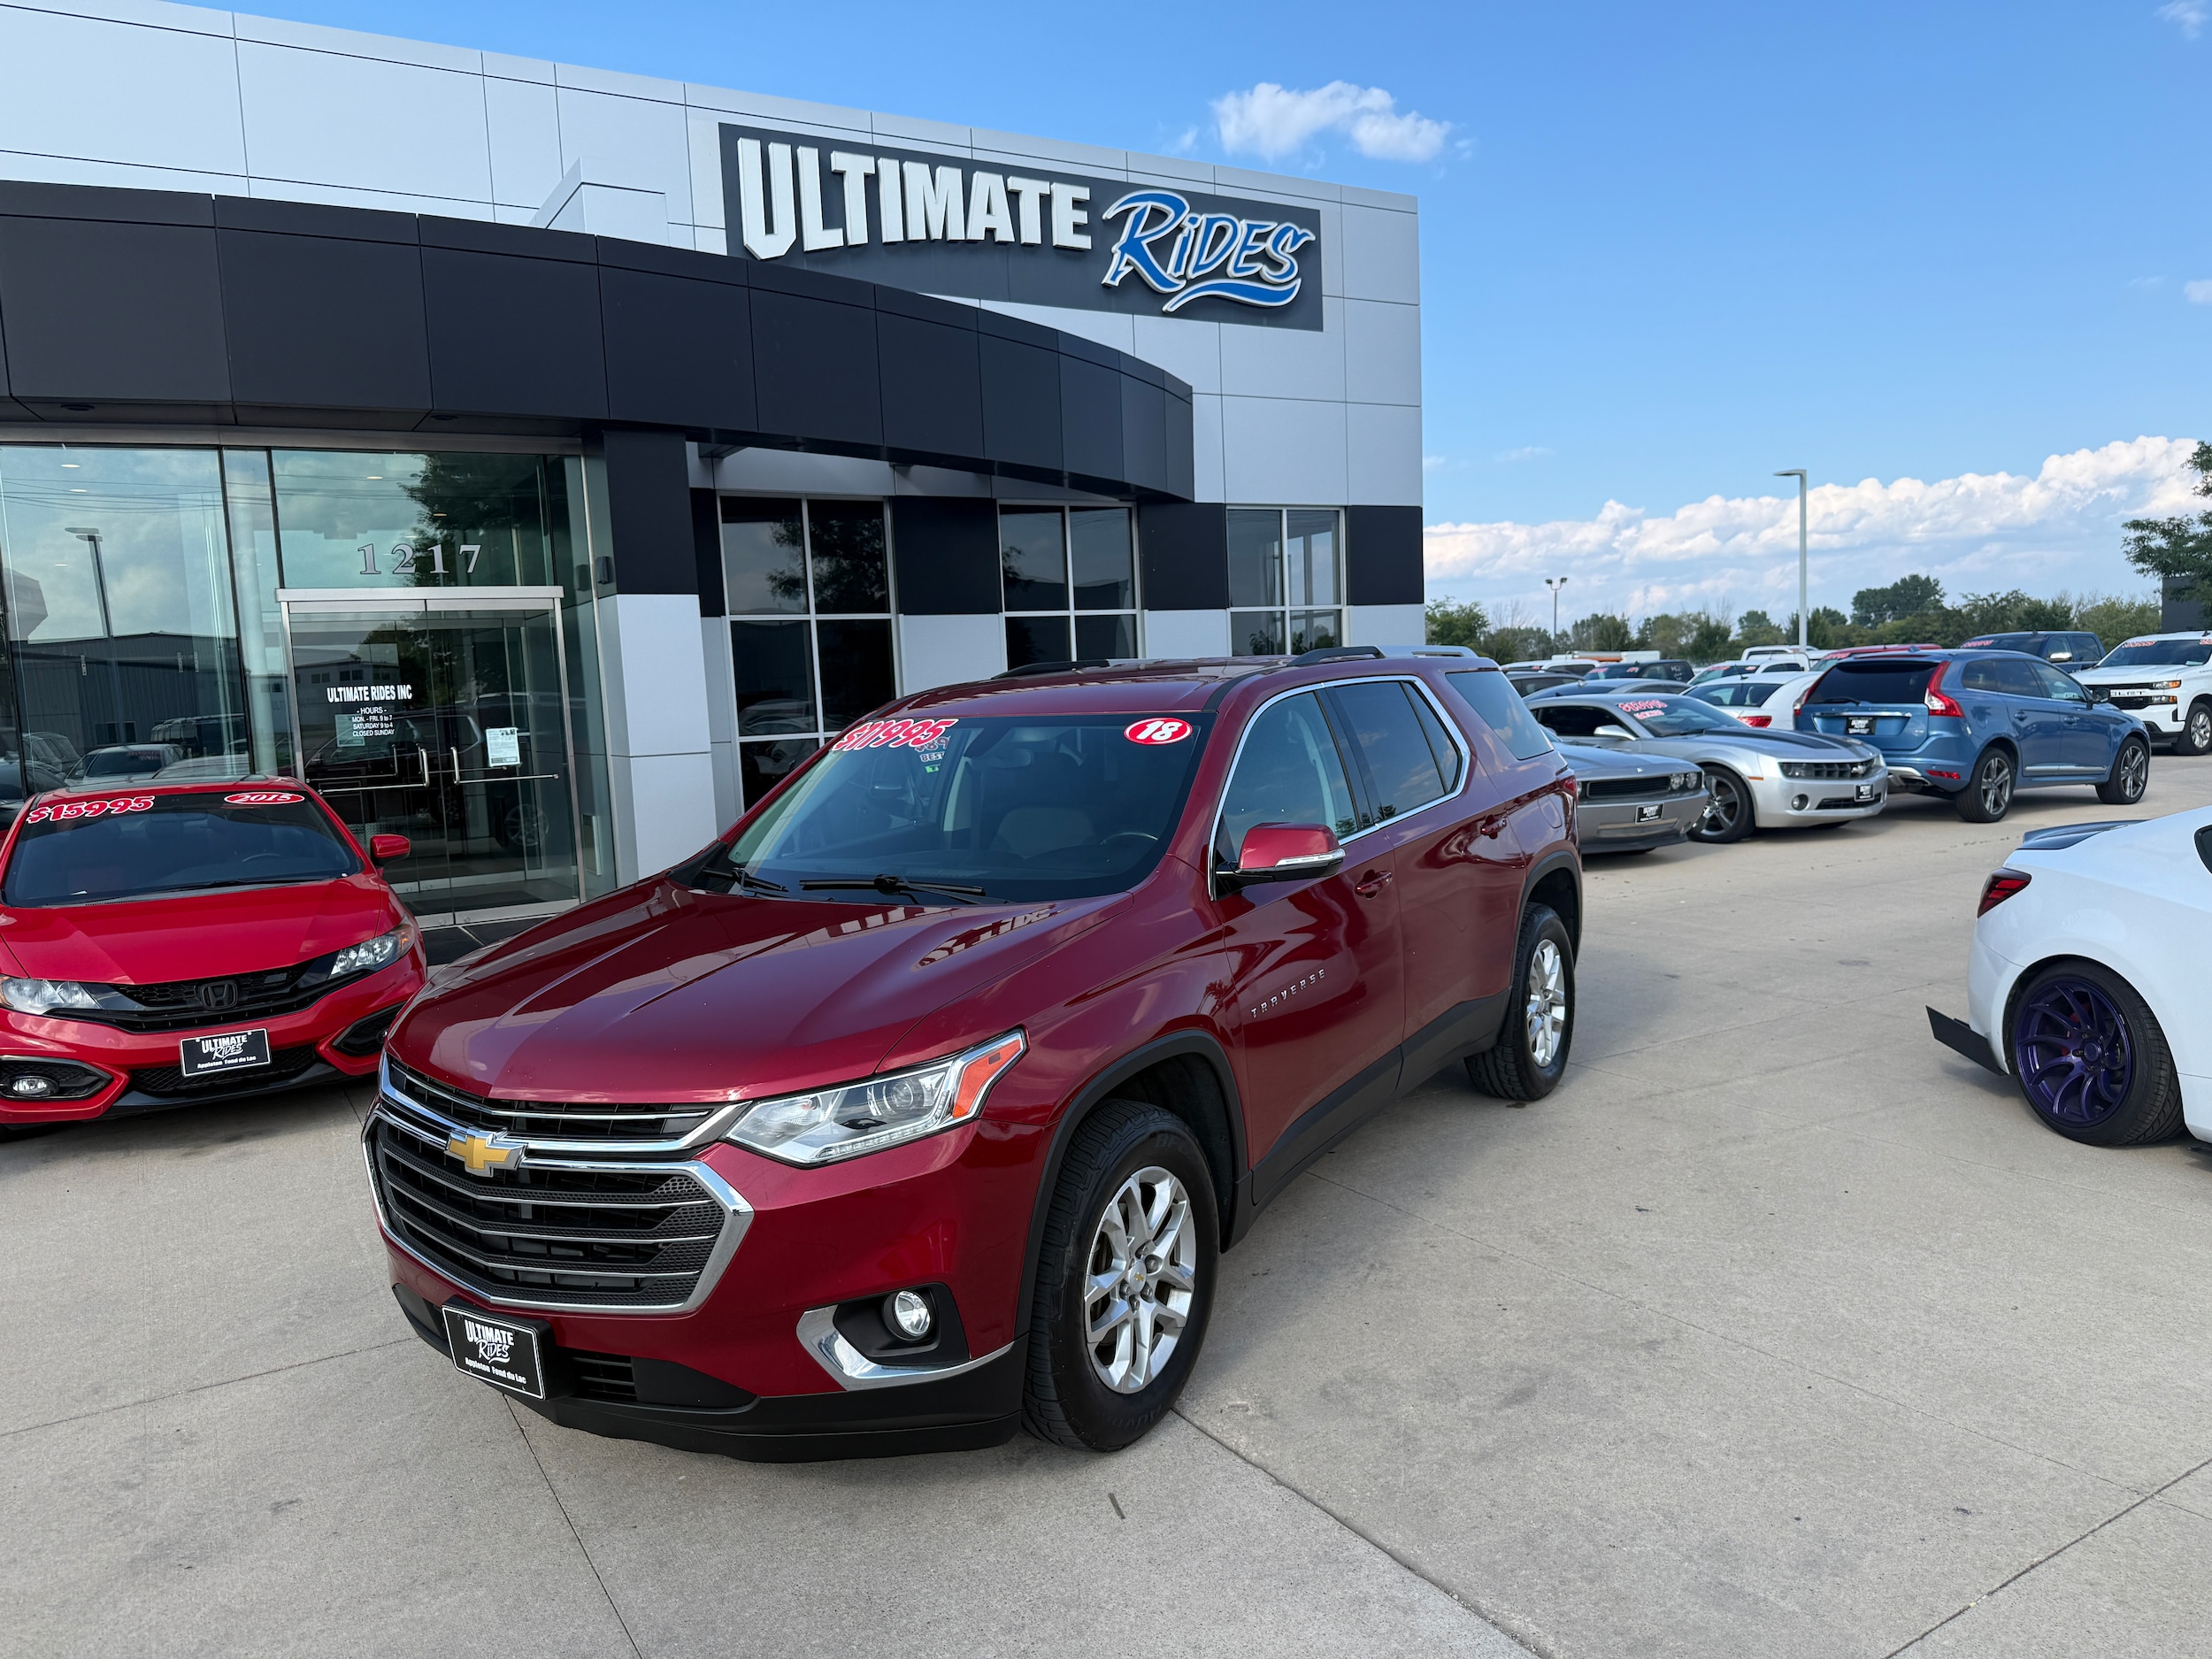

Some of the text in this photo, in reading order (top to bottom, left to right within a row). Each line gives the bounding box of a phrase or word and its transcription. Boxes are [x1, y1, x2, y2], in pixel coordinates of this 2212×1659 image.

[737, 136, 1092, 261] ULTIMATE
[357, 542, 482, 575] 1217
[326, 684, 413, 703] ULTIMATE RIDES INC
[832, 718, 959, 752] $11995
[1135, 720, 1183, 741] 18
[26, 795, 156, 824] $15995
[234, 793, 293, 803] 2015
[1250, 968, 1325, 1018] TRAVERSE
[201, 1034, 248, 1054] ULTIMATE
[464, 1319, 515, 1346] ULTIMATE
[465, 1356, 527, 1385] Appleton Fond du Lac
